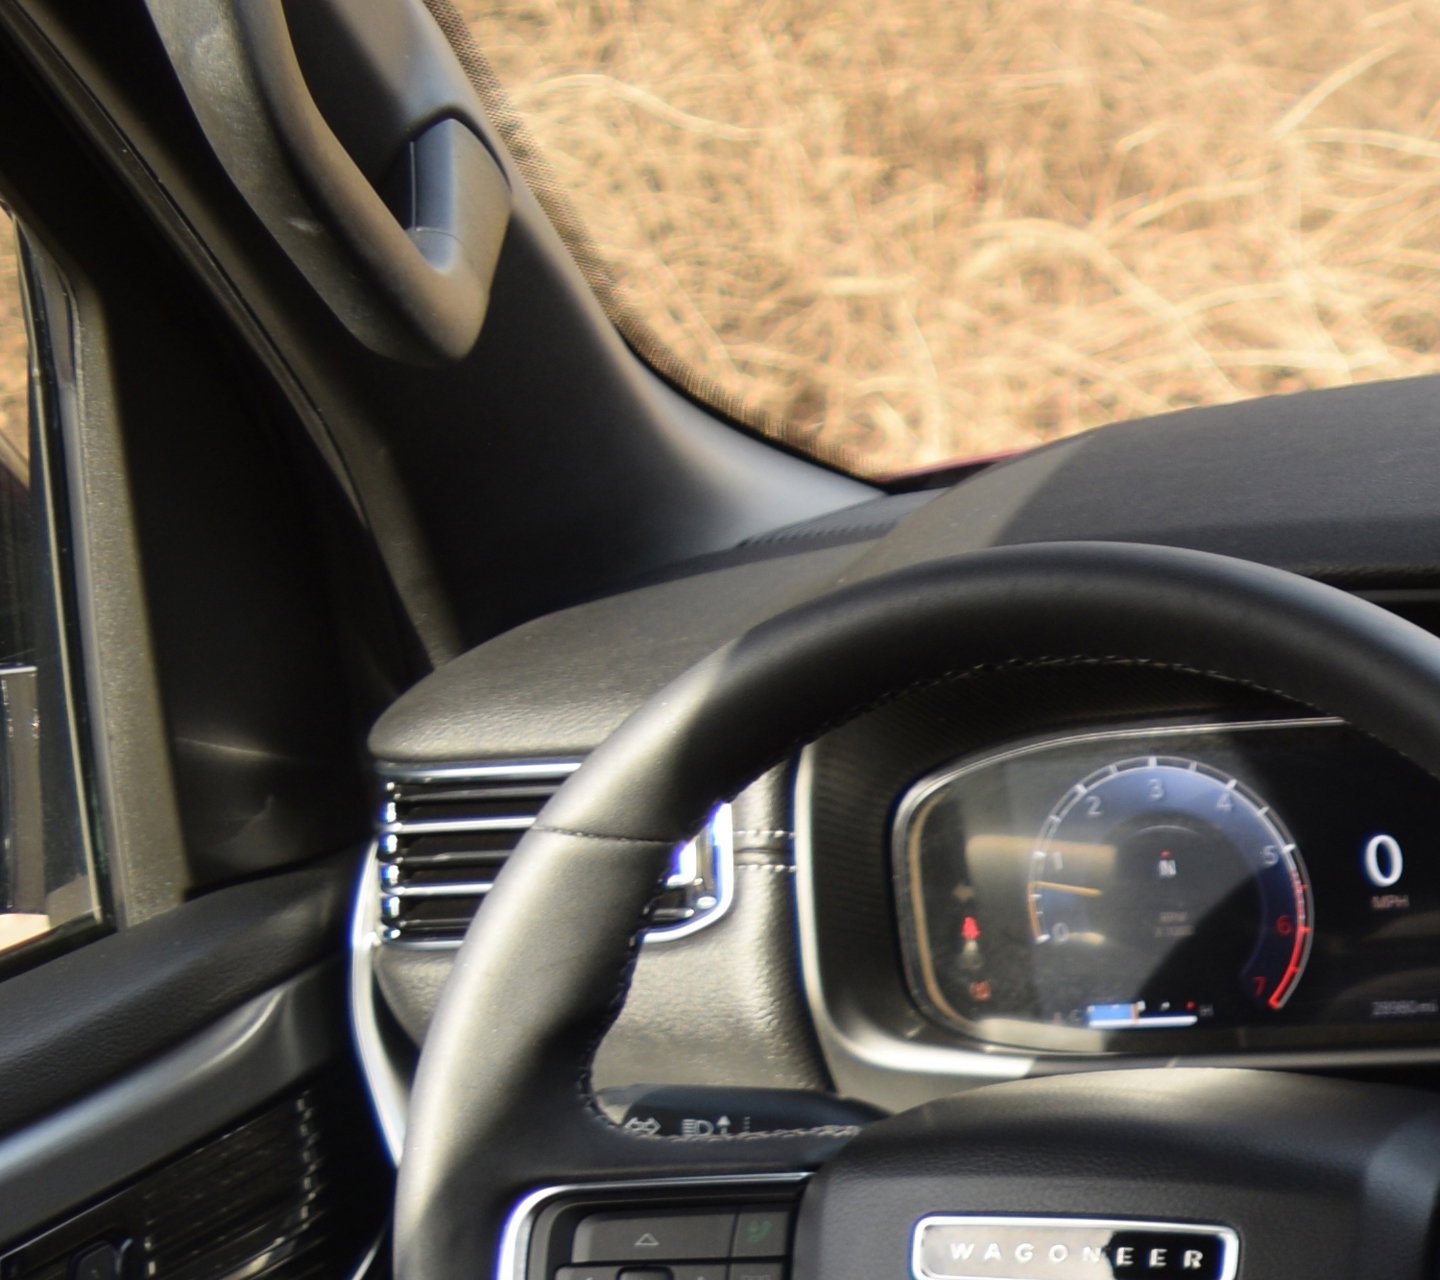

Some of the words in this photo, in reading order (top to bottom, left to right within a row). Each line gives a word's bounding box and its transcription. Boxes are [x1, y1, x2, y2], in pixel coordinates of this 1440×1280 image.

[1148, 779, 1165, 799] 3
[1086, 795, 1103, 816] 2
[1217, 791, 1233, 812] 4
[1261, 846, 1278, 866] 5
[1365, 834, 1404, 888] 0
[1371, 895, 1410, 908] MPH
[1053, 922, 1069, 943] 0
[1276, 915, 1292, 935] 6
[1252, 976, 1266, 996] 7
[949, 1242, 1204, 1268] WAGONEER
